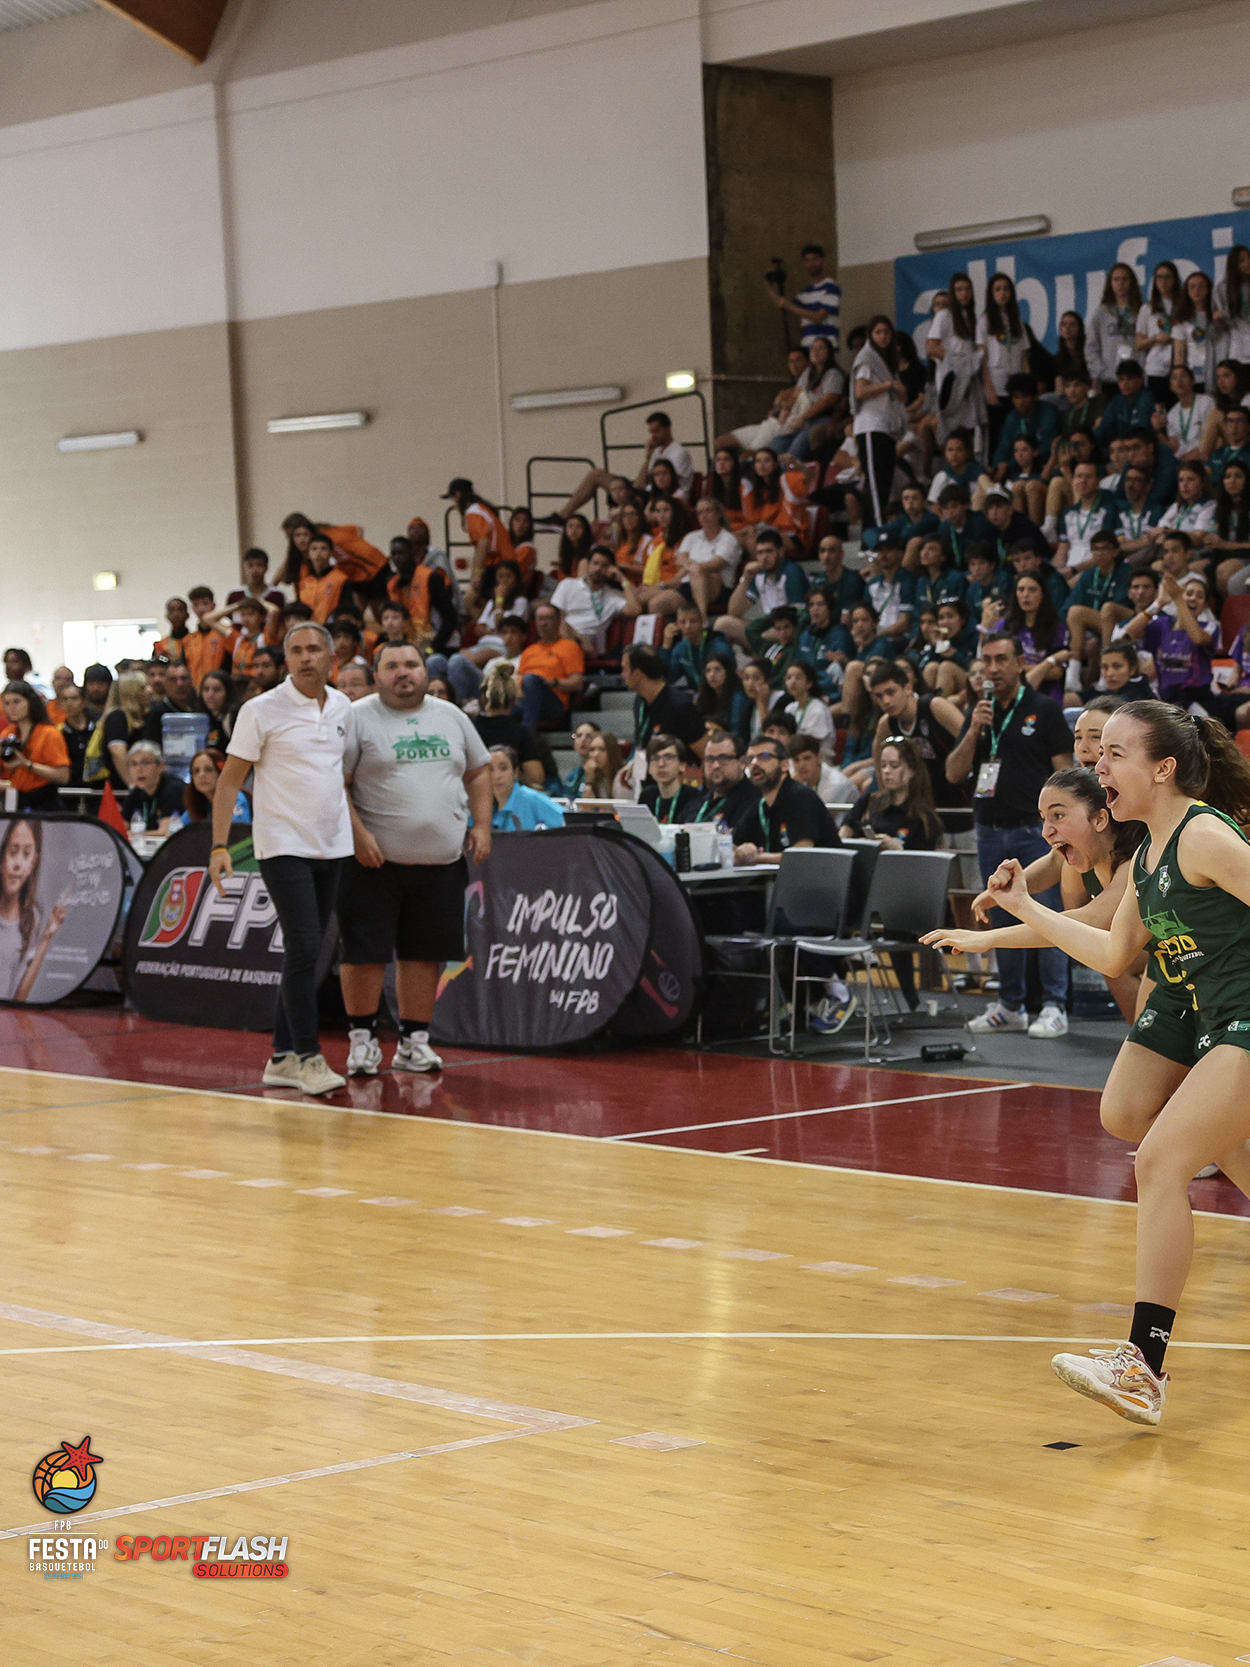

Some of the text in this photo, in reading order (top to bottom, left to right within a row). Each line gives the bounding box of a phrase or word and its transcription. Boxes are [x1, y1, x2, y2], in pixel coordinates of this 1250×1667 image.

[396, 748, 450, 760] PORTO
[188, 872, 285, 953] FP
[507, 889, 618, 938] IMPULSO
[230, 968, 242, 982] DE
[484, 939, 614, 984] FEMININO
[564, 988, 600, 1014] FPB
